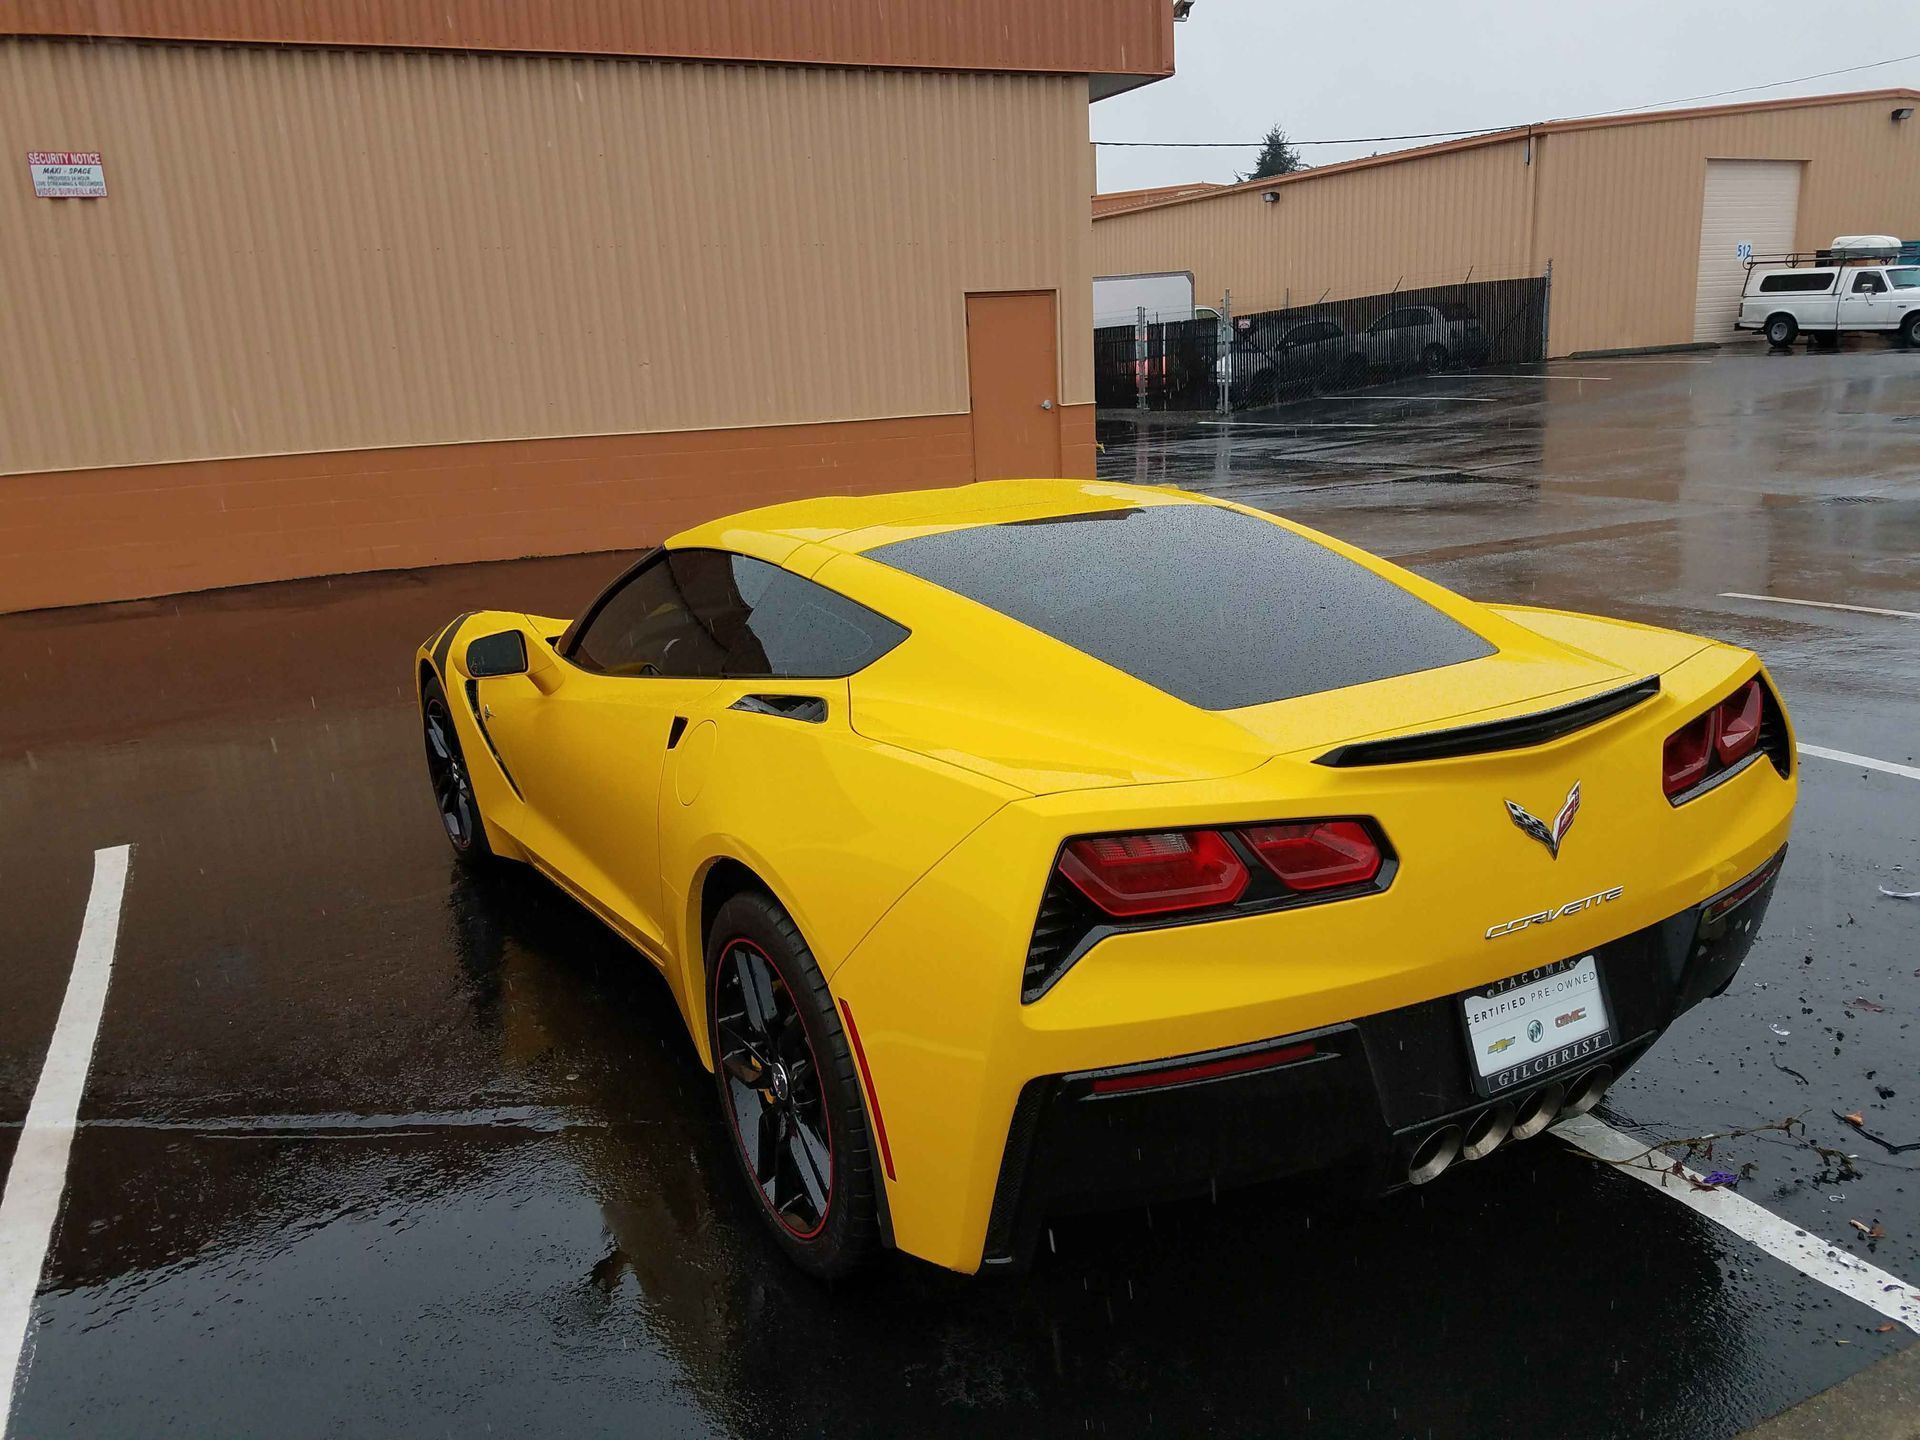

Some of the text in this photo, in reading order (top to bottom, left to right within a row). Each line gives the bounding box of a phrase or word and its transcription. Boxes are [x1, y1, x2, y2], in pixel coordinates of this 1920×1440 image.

[28, 153, 102, 164] SECURITY NOTICE
[43, 167, 62, 175] MAXI
[69, 167, 92, 175] SPACE
[38, 187, 106, 196] VIDEO SURVEILLANCE
[1738, 244, 1751, 257] 512
[1485, 885, 1625, 939] CORVETTE
[1497, 960, 1567, 992] TACOMA
[1530, 970, 1596, 1002] PRE-OWNED
[1554, 1006, 1588, 1029] GMC
[1498, 1035, 1602, 1087] GILCHRIST
